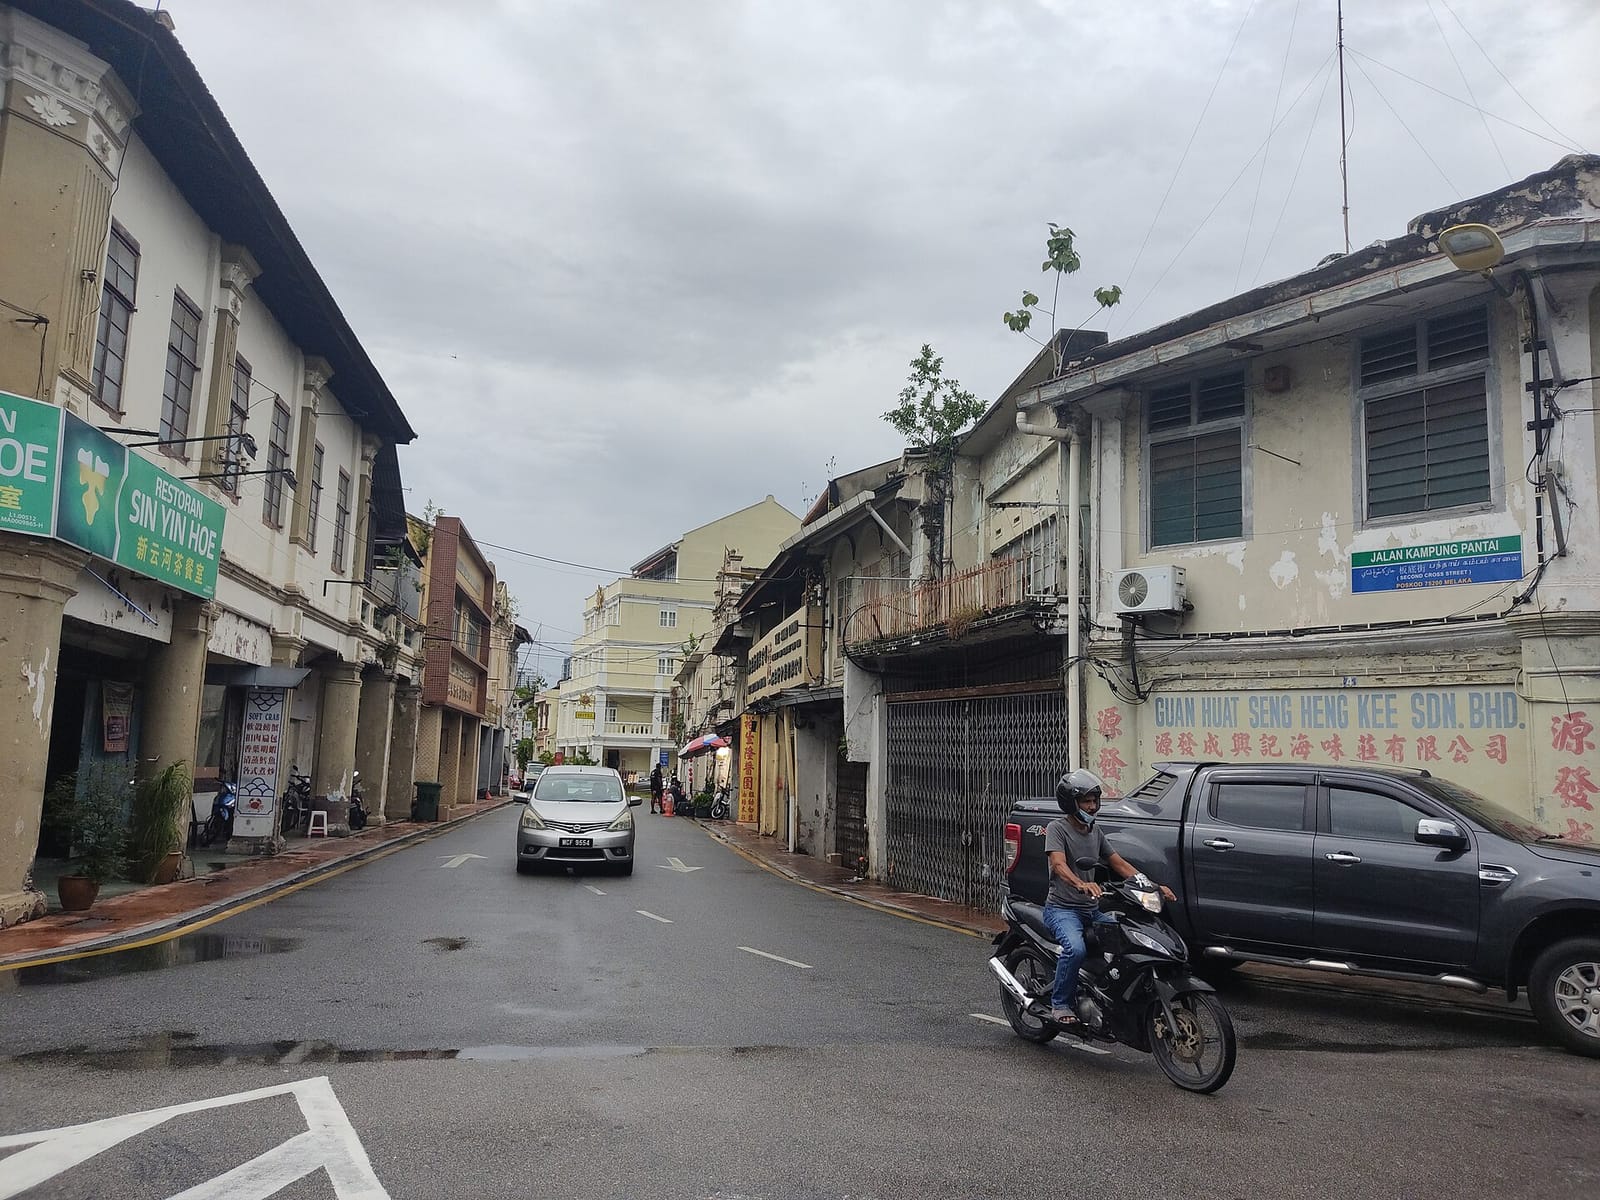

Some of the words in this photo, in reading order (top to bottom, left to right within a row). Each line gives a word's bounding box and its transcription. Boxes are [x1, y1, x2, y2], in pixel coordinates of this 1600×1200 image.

[155, 476, 204, 520] RESTORAN
[129, 489, 158, 532] SIN
[161, 503, 187, 546] YIN
[188, 520, 217, 560] HOE
[136, 535, 205, 585] 新云河茶餐室
[1370, 549, 1403, 563] JALAN
[1405, 543, 1459, 560] KAMPUNG
[1461, 539, 1499, 554] PANTAI
[1396, 581, 1423, 589] POSKOD
[1444, 578, 1472, 586] MELAKA
[1424, 571, 1444, 579] CROSS
[248, 712, 263, 721] SOFT
[265, 713, 280, 721] CRAB
[1155, 697, 1196, 727] GUAN
[1202, 697, 1239, 728] HUAT
[1249, 695, 1292, 729] SENG
[1301, 694, 1348, 729] HENG
[1358, 694, 1399, 729] KEE
[1411, 692, 1464, 729] SDN.
[1468, 691, 1526, 730] BHD.
[1097, 706, 1128, 798] 源發
